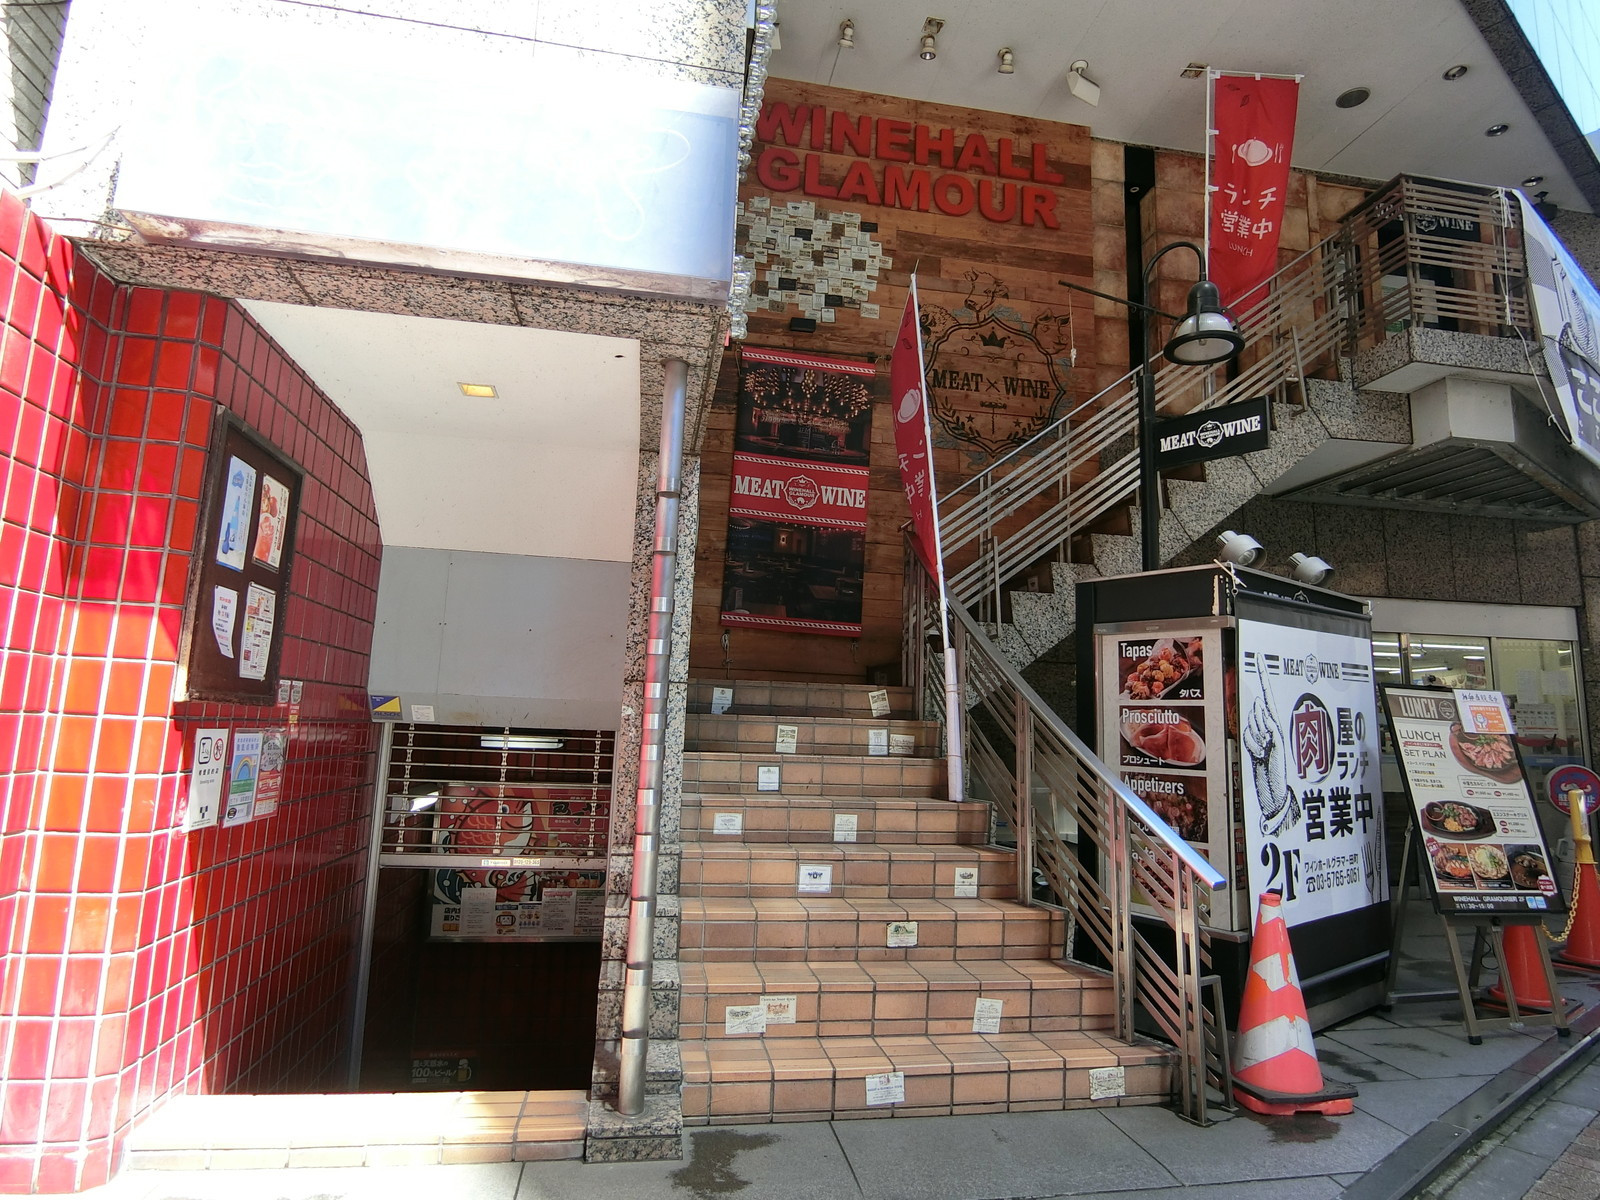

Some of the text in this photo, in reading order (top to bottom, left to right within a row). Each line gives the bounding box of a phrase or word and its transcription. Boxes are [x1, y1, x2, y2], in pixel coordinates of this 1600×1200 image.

[757, 102, 1064, 184] WINEHALL
[757, 145, 1060, 229] GLAMOUR
[1224, 182, 1277, 210] ランチ
[1220, 209, 1273, 239] 営業中
[1228, 241, 1253, 257] LUNCH
[932, 368, 1050, 399] MEAT WINE
[1160, 431, 1196, 452] MEAT
[1222, 415, 1260, 438] WINE
[734, 474, 866, 509] MEAT WINE
[1120, 642, 1153, 660] Tapas
[1283, 657, 1305, 677] MEAT
[1318, 661, 1340, 680] WINE
[1178, 688, 1202, 699] タパス
[1122, 708, 1180, 726] Prosciutto
[1399, 696, 1438, 719] LUNCH
[1296, 705, 1366, 779] 肉 屋の
[1399, 729, 1442, 742] LUNCH
[1122, 755, 1166, 766] プロシュート
[1336, 751, 1369, 781] ランチ
[1404, 749, 1446, 759] SET PLAN
[1122, 774, 1184, 795] Appetizers
[1302, 784, 1374, 843] 営業中
[1261, 842, 1301, 901] 2F
[1304, 853, 1359, 873] ワインホールグラマー田町
[1316, 866, 1360, 891] 03-5765-5051
